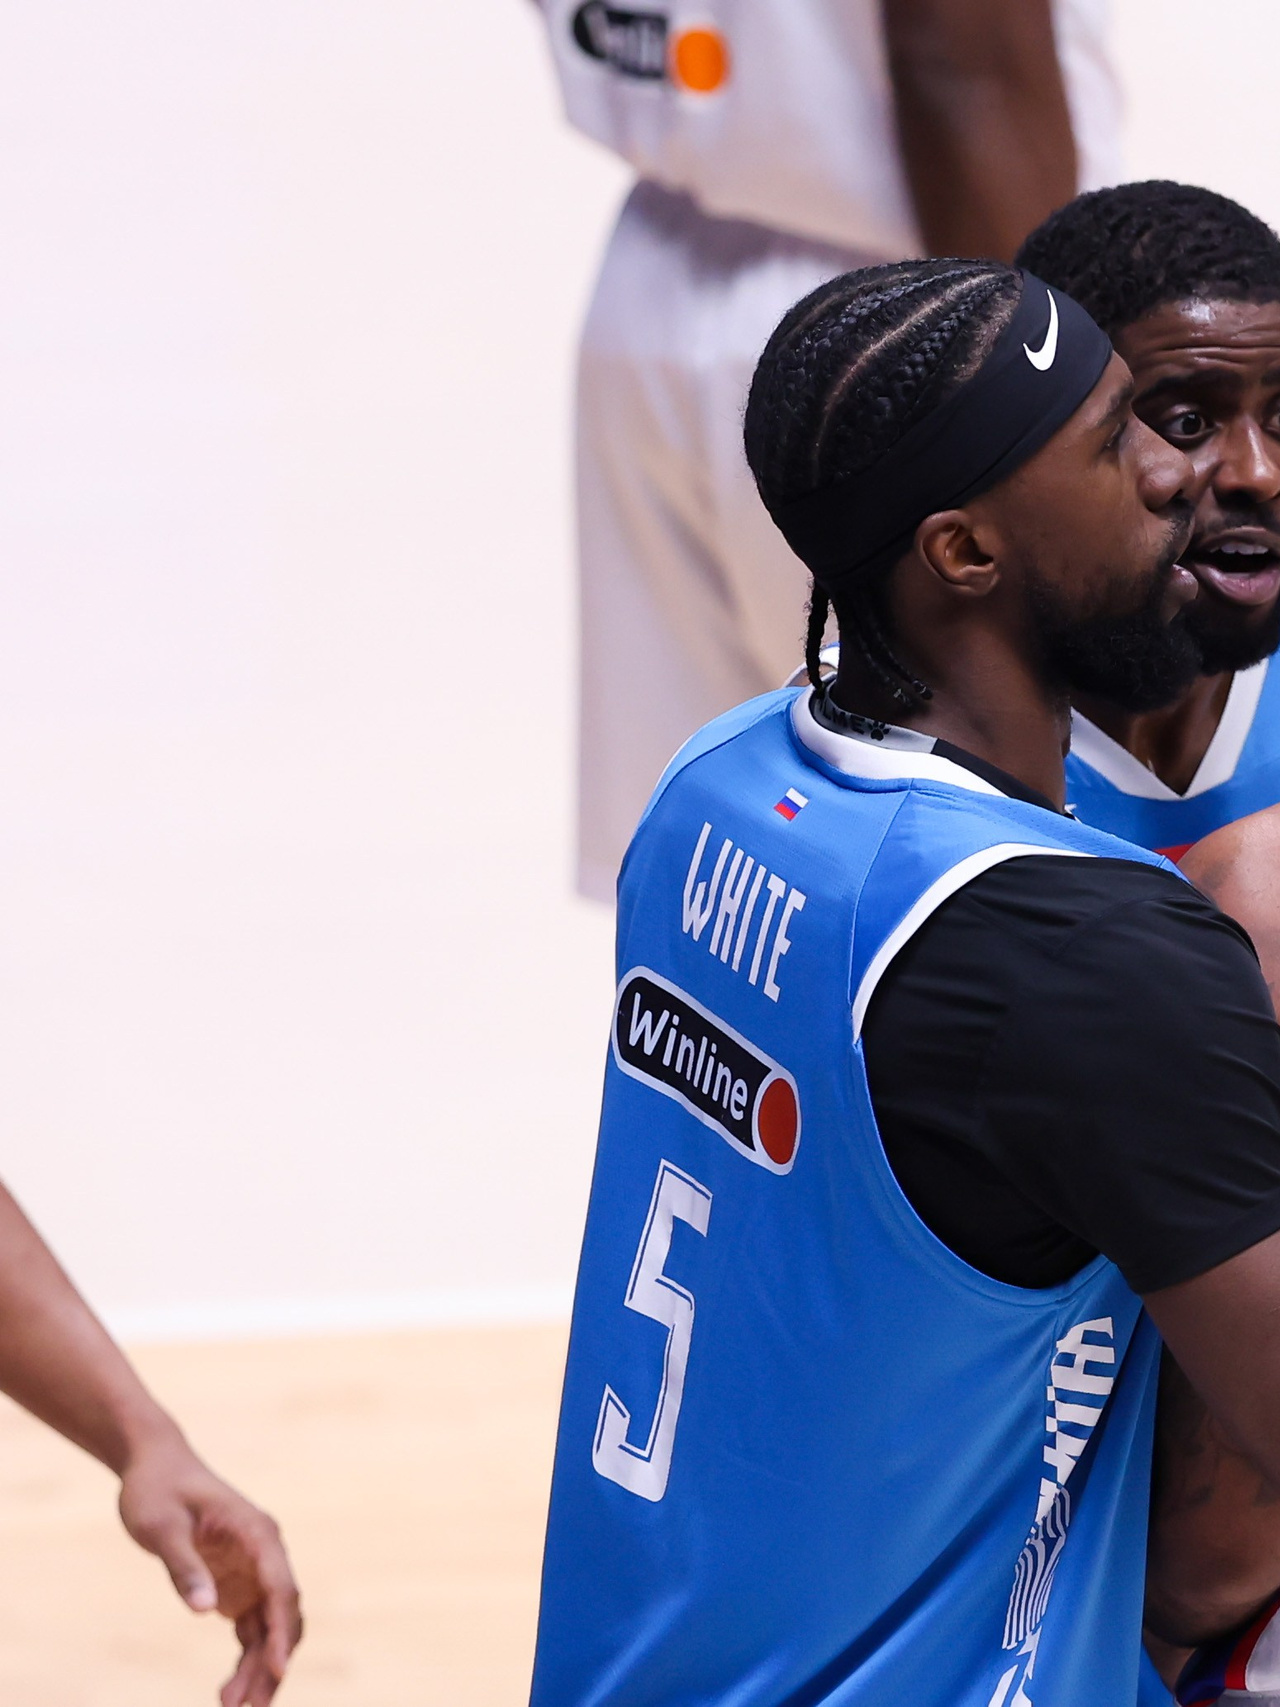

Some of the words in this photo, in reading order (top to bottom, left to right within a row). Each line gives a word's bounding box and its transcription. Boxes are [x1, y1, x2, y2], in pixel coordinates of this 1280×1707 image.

[682, 821, 807, 1003] WHITE
[628, 992, 748, 1121] Winline
[591, 1158, 713, 1502] 5
